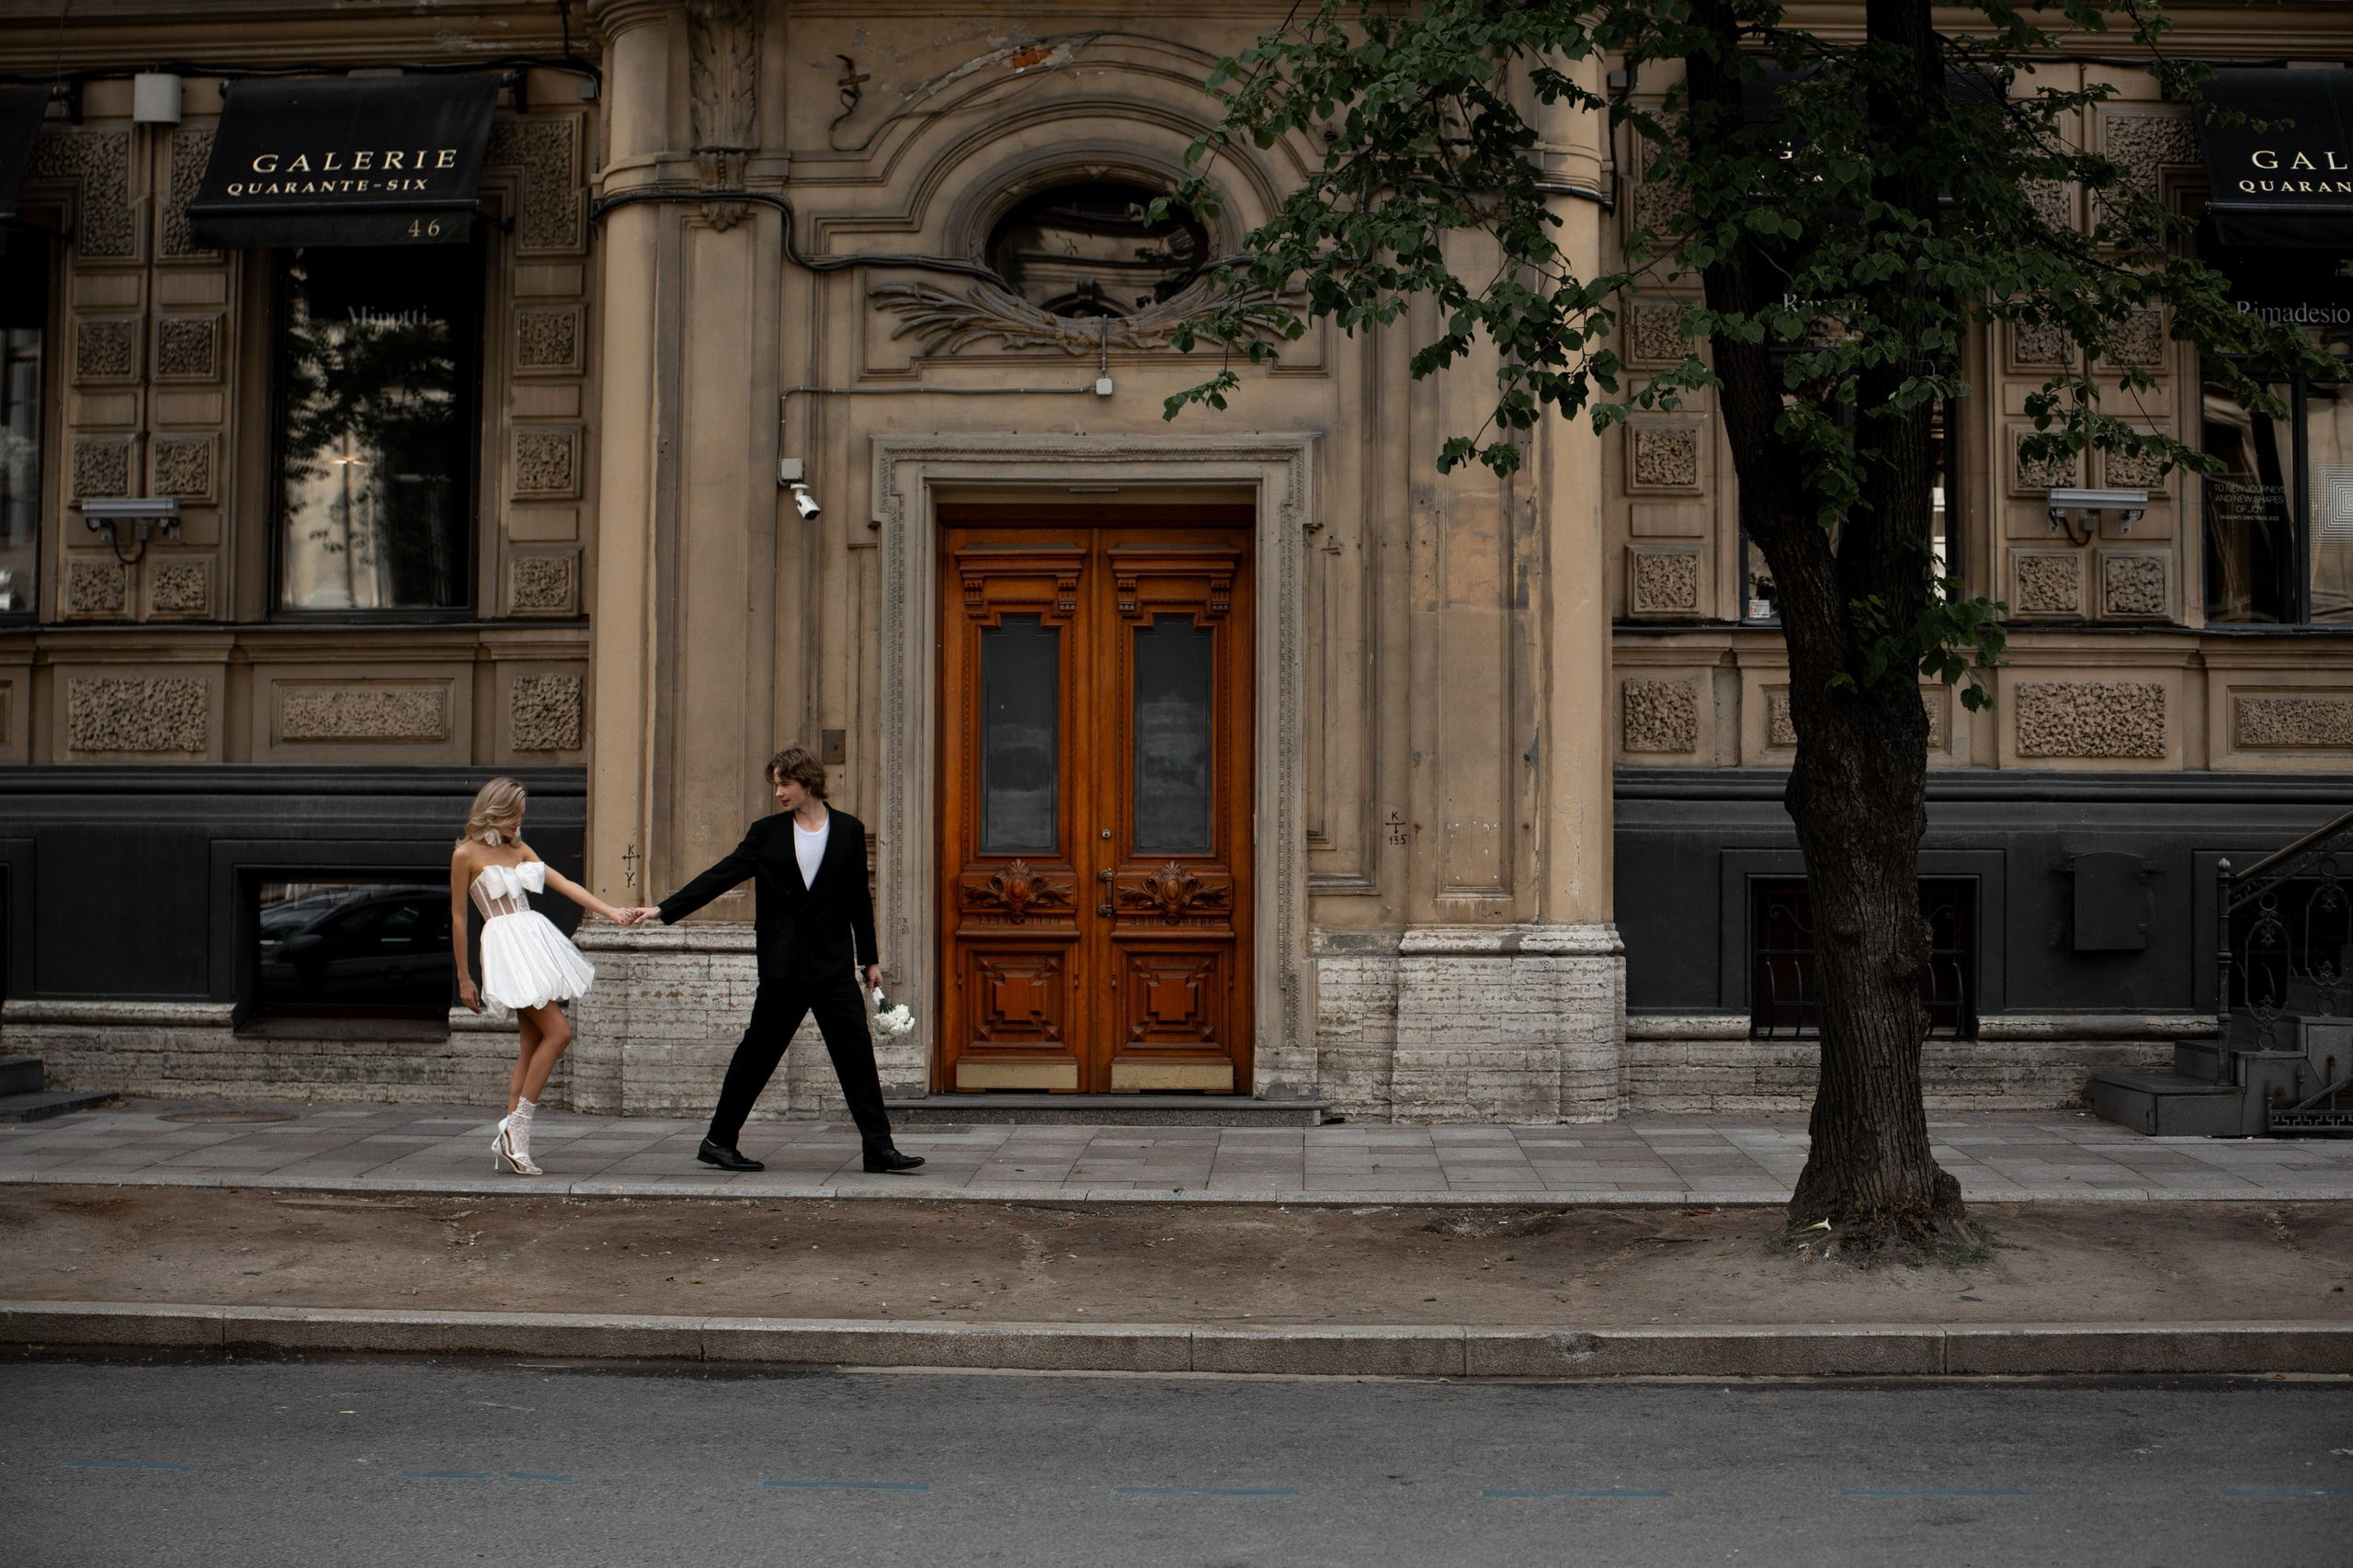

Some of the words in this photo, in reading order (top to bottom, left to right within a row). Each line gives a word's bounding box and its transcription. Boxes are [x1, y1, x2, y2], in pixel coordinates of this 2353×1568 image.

[252, 149, 457, 174] GALERIE
[2251, 150, 2348, 170] GAL
[227, 178, 428, 197] QUARANTE-SIX
[407, 218, 440, 237] 46
[2235, 300, 2351, 324] Rimadesio
[2213, 483, 2224, 492] TO
[2225, 483, 2245, 493] NEW
[2245, 484, 2287, 494] JOURNEYS
[2215, 494, 2233, 503] AND
[2234, 494, 2252, 503] NEW
[2253, 494, 2284, 504] SHAPES
[2235, 505, 2246, 513] OF
